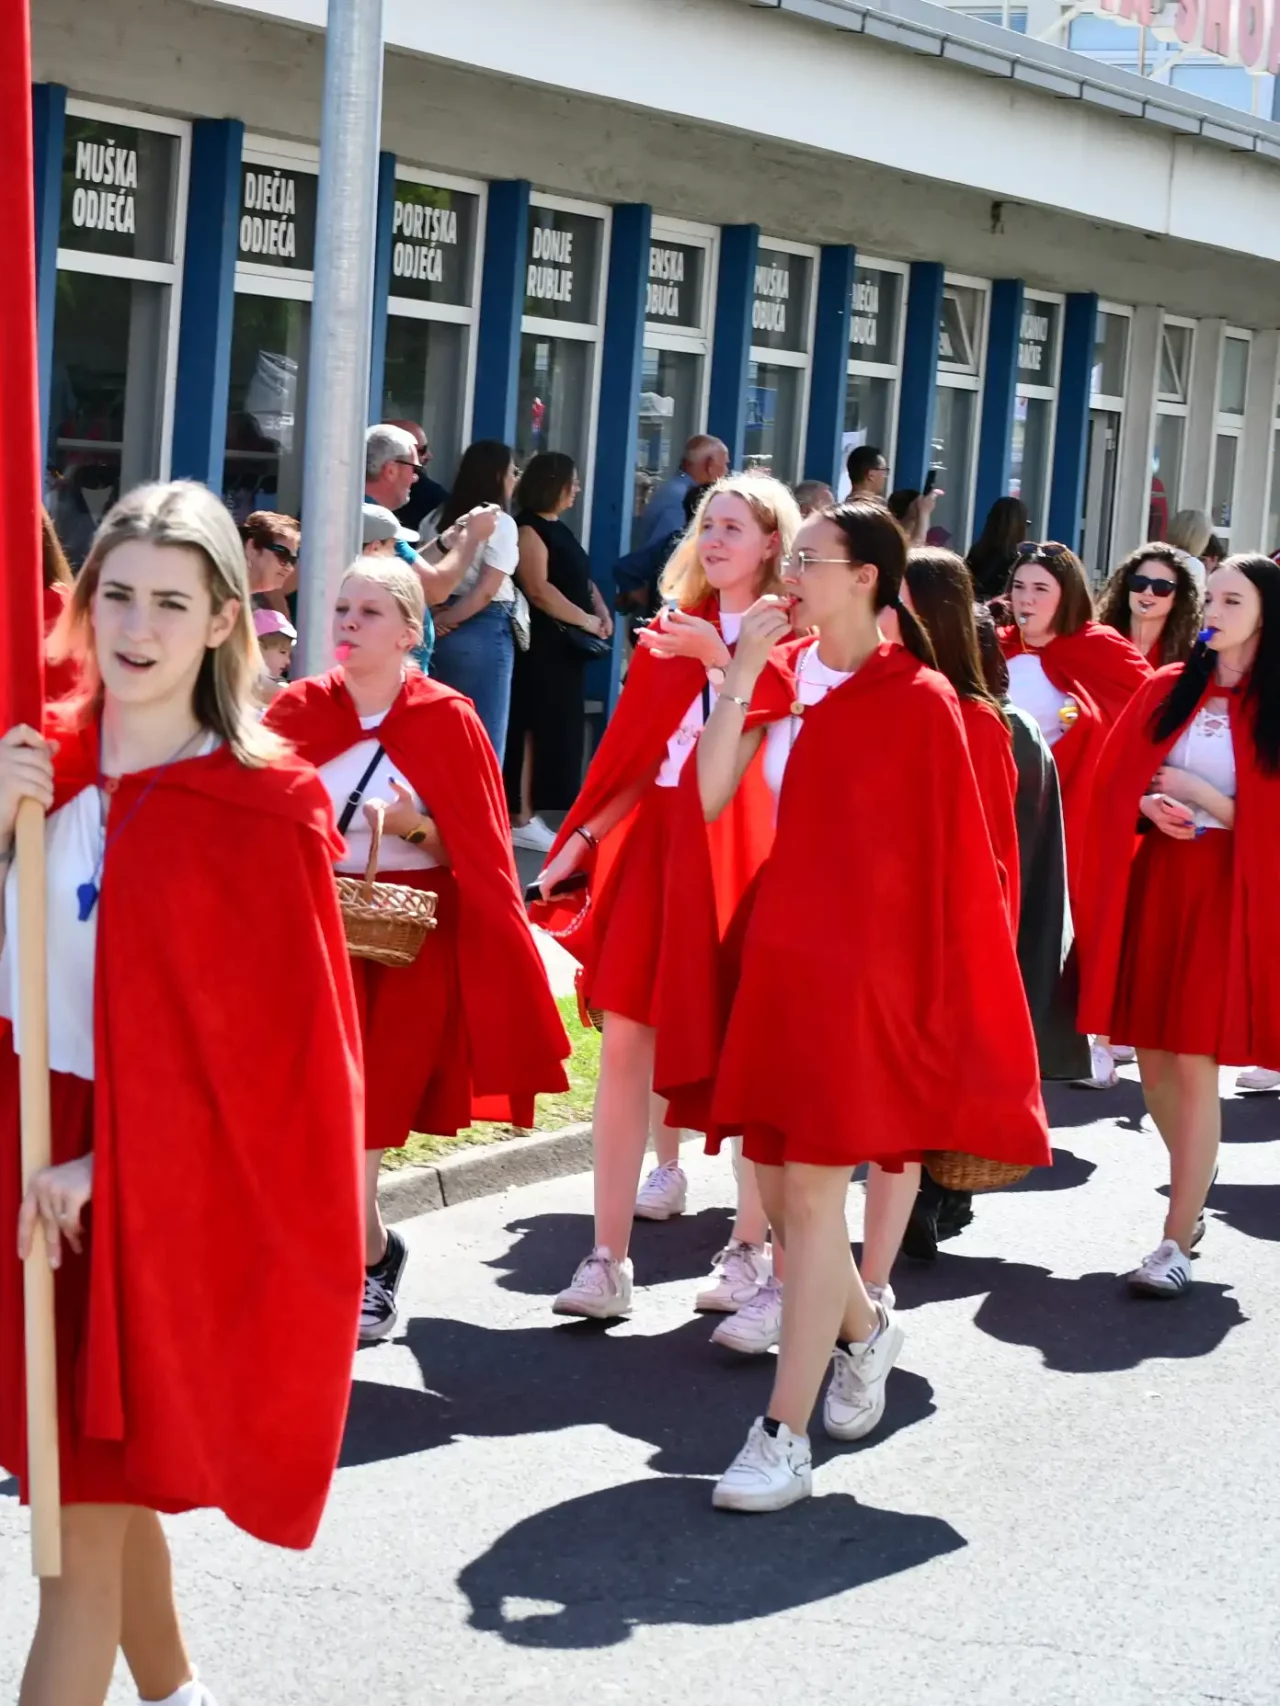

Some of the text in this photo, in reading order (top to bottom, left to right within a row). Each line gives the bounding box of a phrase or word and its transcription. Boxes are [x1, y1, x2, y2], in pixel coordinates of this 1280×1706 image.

[75, 139, 138, 189] MUŠKA
[72, 188, 136, 235] ODJEĆA
[244, 170, 296, 215] DJEČJA
[239, 214, 296, 259] ODJEĆA
[393, 200, 458, 245] PORTSKA
[393, 242, 443, 283] ODJEĆA
[532, 227, 573, 264] DONJE
[526, 265, 573, 302] RUBLJE
